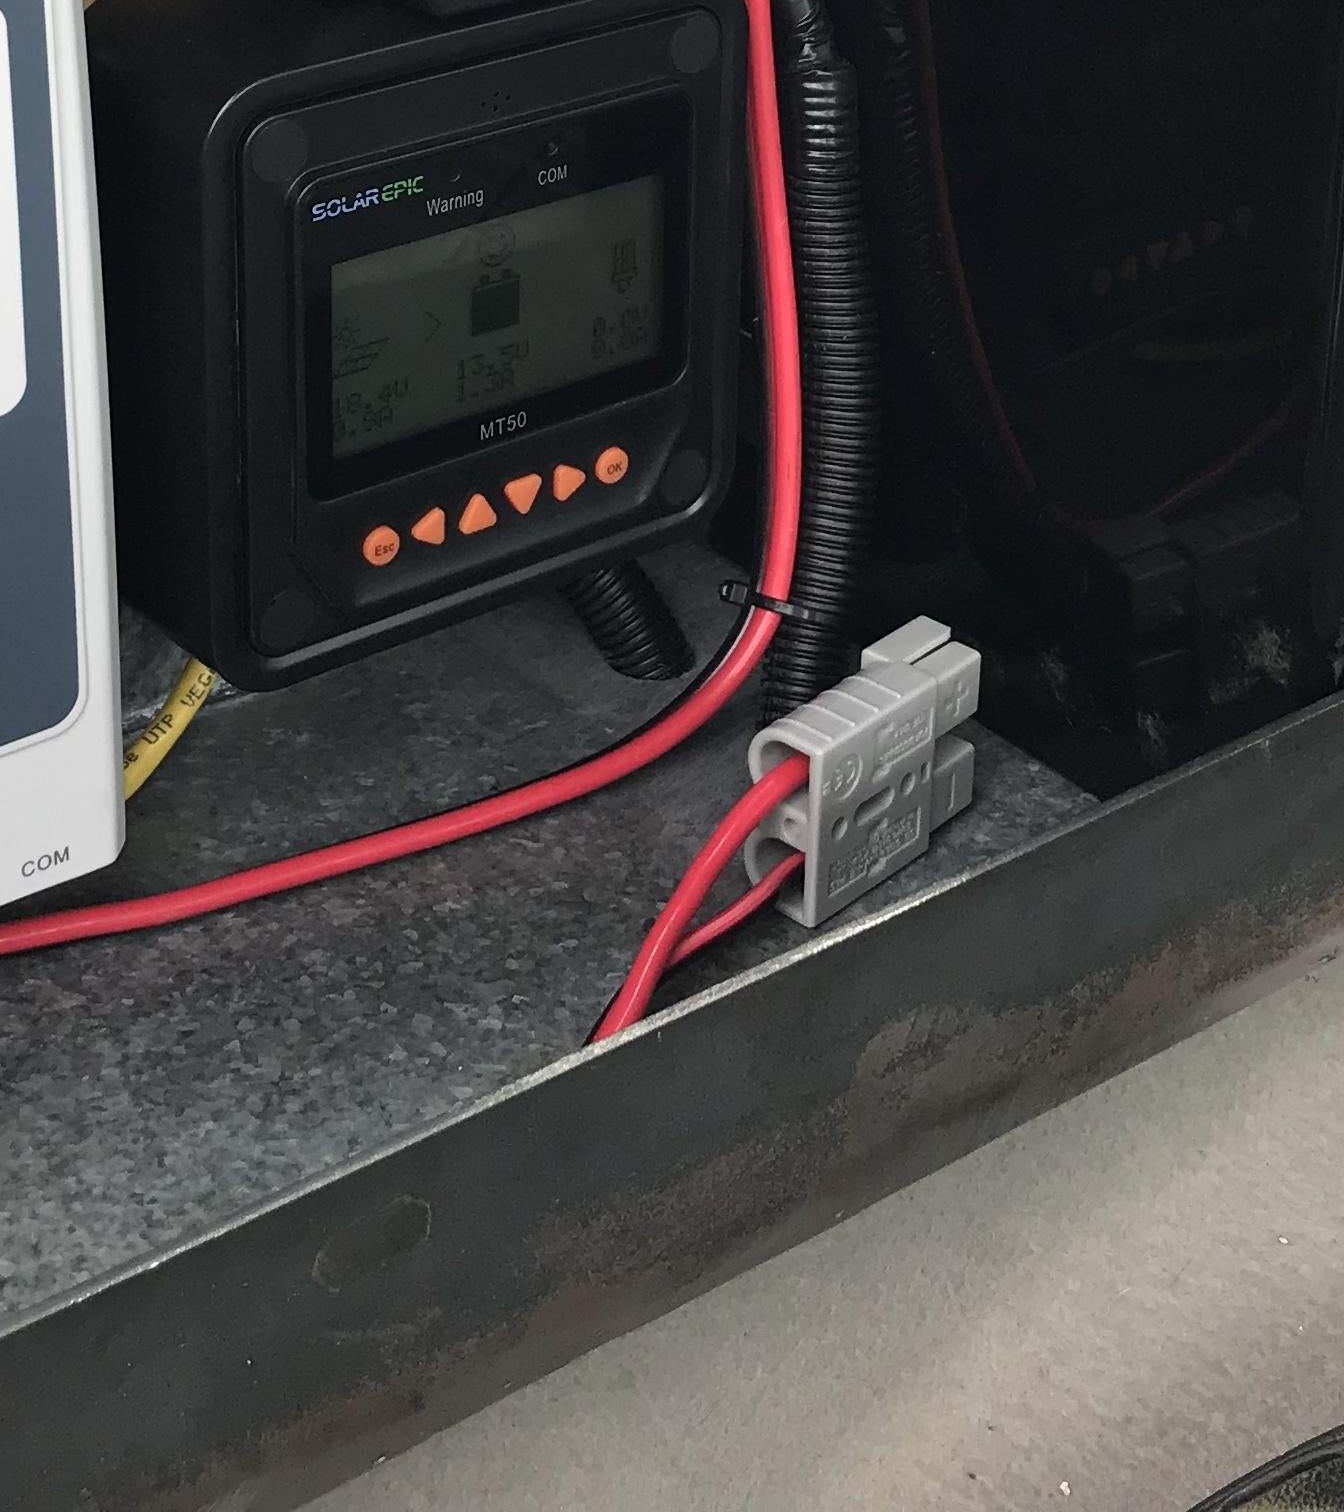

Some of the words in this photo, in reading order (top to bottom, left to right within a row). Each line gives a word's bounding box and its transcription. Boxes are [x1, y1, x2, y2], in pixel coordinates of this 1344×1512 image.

[537, 164, 569, 186] COM
[426, 189, 485, 217] Warning
[479, 411, 528, 441] MT50
[606, 461, 623, 475] OK
[374, 541, 396, 558] Esc
[141, 713, 175, 745] UTP
[20, 846, 71, 879] COM
